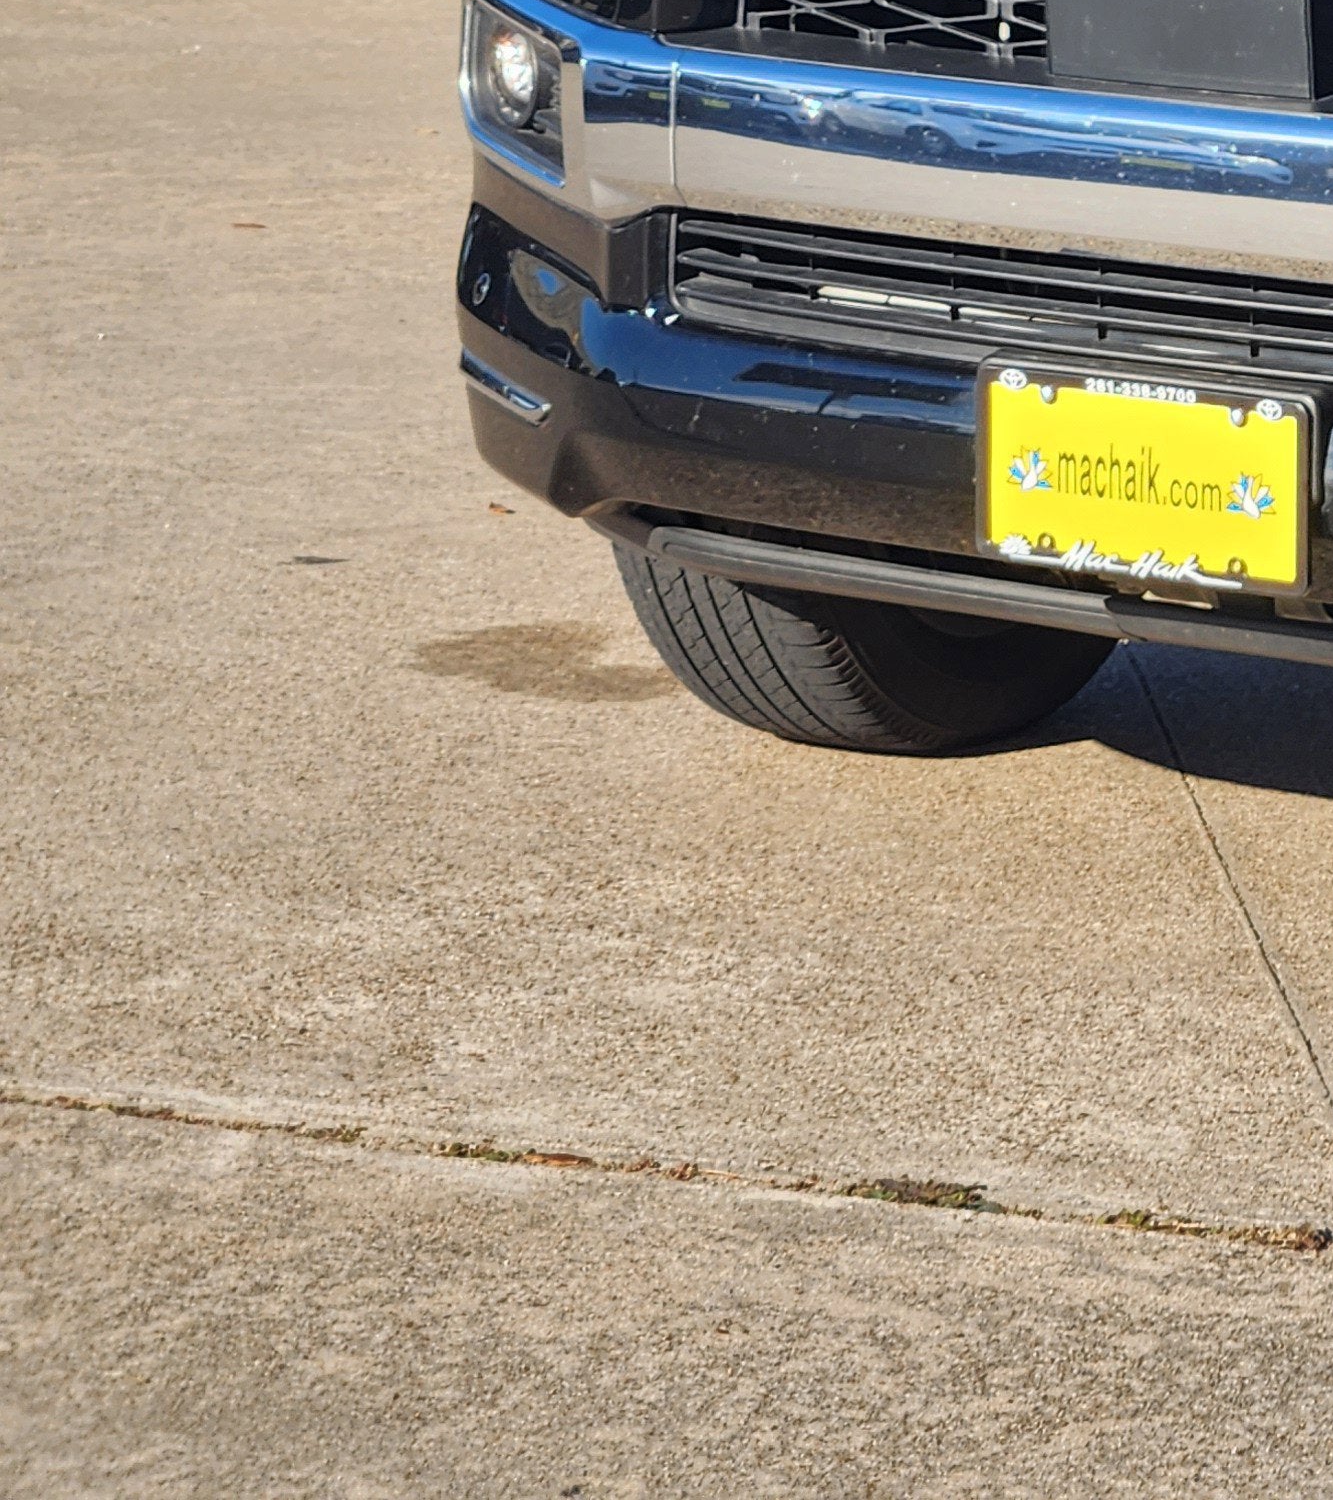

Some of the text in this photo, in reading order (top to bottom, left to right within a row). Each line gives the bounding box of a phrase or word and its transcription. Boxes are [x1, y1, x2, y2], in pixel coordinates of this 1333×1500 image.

[1056, 442, 1222, 512] machaik.com
[1060, 538, 1216, 583] Mac Haik
